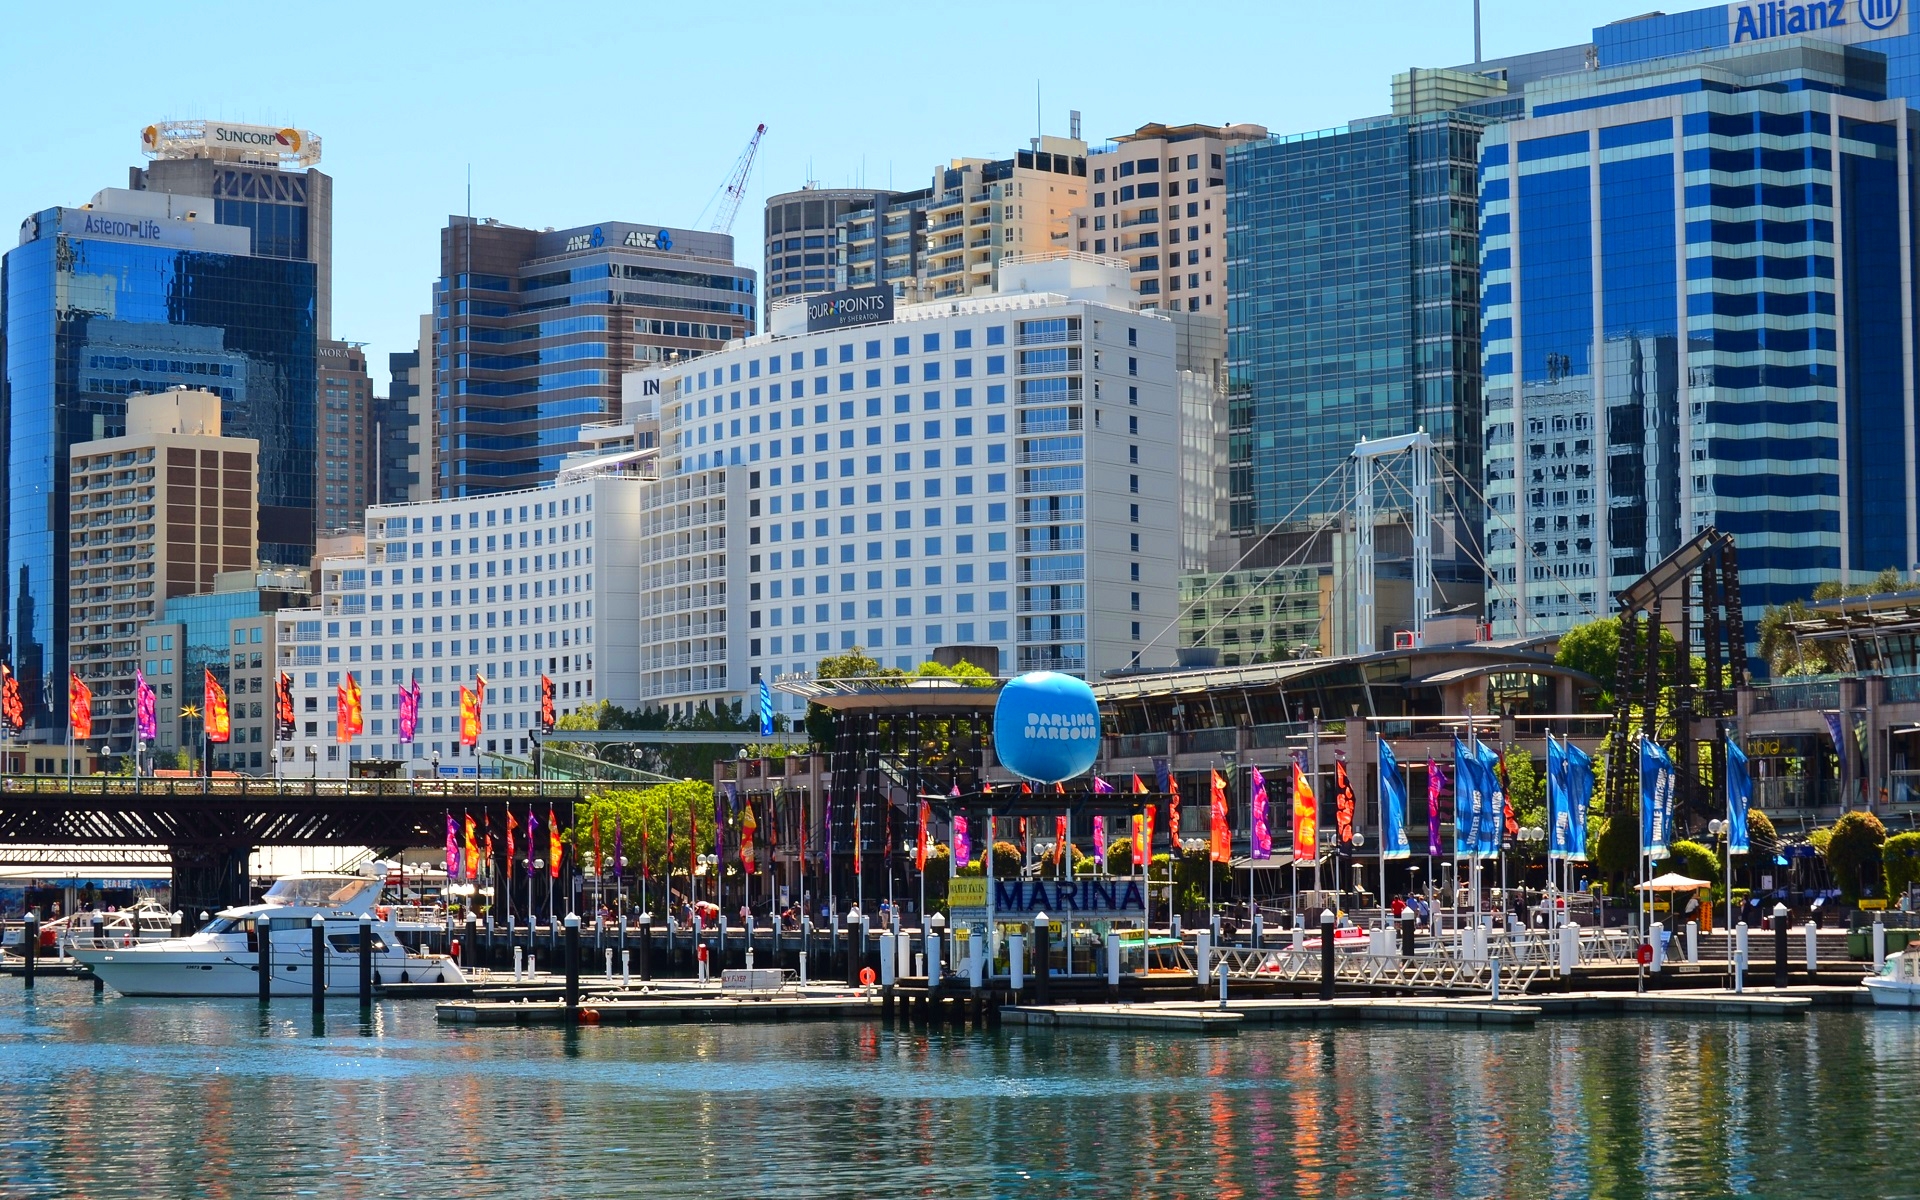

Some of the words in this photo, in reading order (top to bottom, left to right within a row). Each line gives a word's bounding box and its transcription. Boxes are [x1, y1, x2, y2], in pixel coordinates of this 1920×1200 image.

[1734, 0, 1847, 43] Allianz
[216, 127, 276, 146] SUNCORP
[84, 215, 132, 237] Asteron
[138, 219, 160, 240] Life
[565, 234, 591, 252] ANZ
[623, 231, 657, 249] ANZ
[808, 302, 829, 320] FOUR
[839, 295, 885, 314] POINTS
[848, 313, 879, 323] SHERATON
[1027, 712, 1095, 727] DARLING
[1024, 726, 1097, 740] HARBOUR
[1652, 810, 1663, 841] WHALE
[102, 879, 117, 889] SEA
[995, 881, 1146, 912] MARINA
